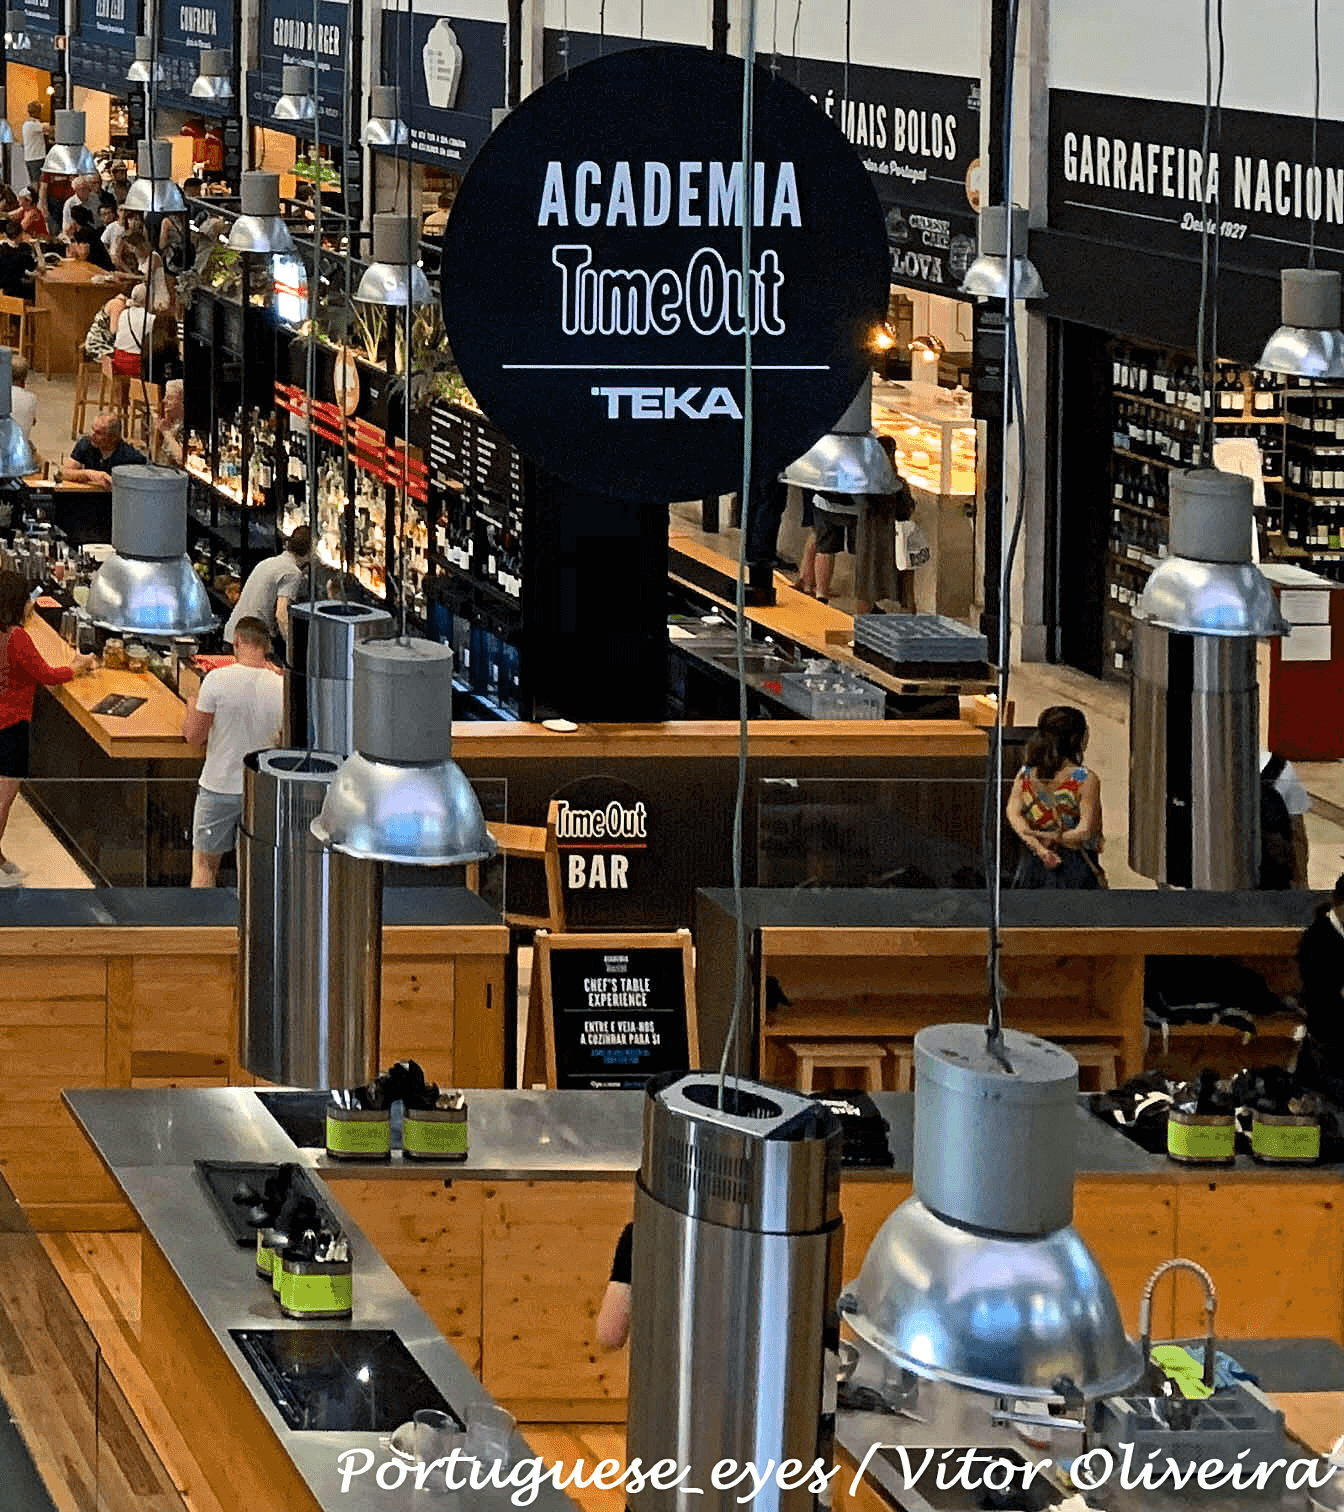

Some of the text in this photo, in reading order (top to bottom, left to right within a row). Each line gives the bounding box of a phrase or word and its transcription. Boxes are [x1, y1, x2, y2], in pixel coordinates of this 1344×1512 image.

[841, 99, 887, 149] MAIS
[894, 107, 957, 160] BOLOS
[1064, 131, 1344, 224] GARRAFEIRA NACION
[537, 160, 802, 227] ACADEMIA
[1219, 221, 1248, 239] 1927
[591, 387, 743, 419] TEKA
[568, 854, 629, 889] BAR
[584, 978, 651, 992] CHEF'S TABLE
[588, 993, 647, 1007] EXPERIENCE
[580, 1033, 587, 1045] A
[628, 1033, 650, 1045] PARA
[584, 1021, 609, 1033] ENTRE
